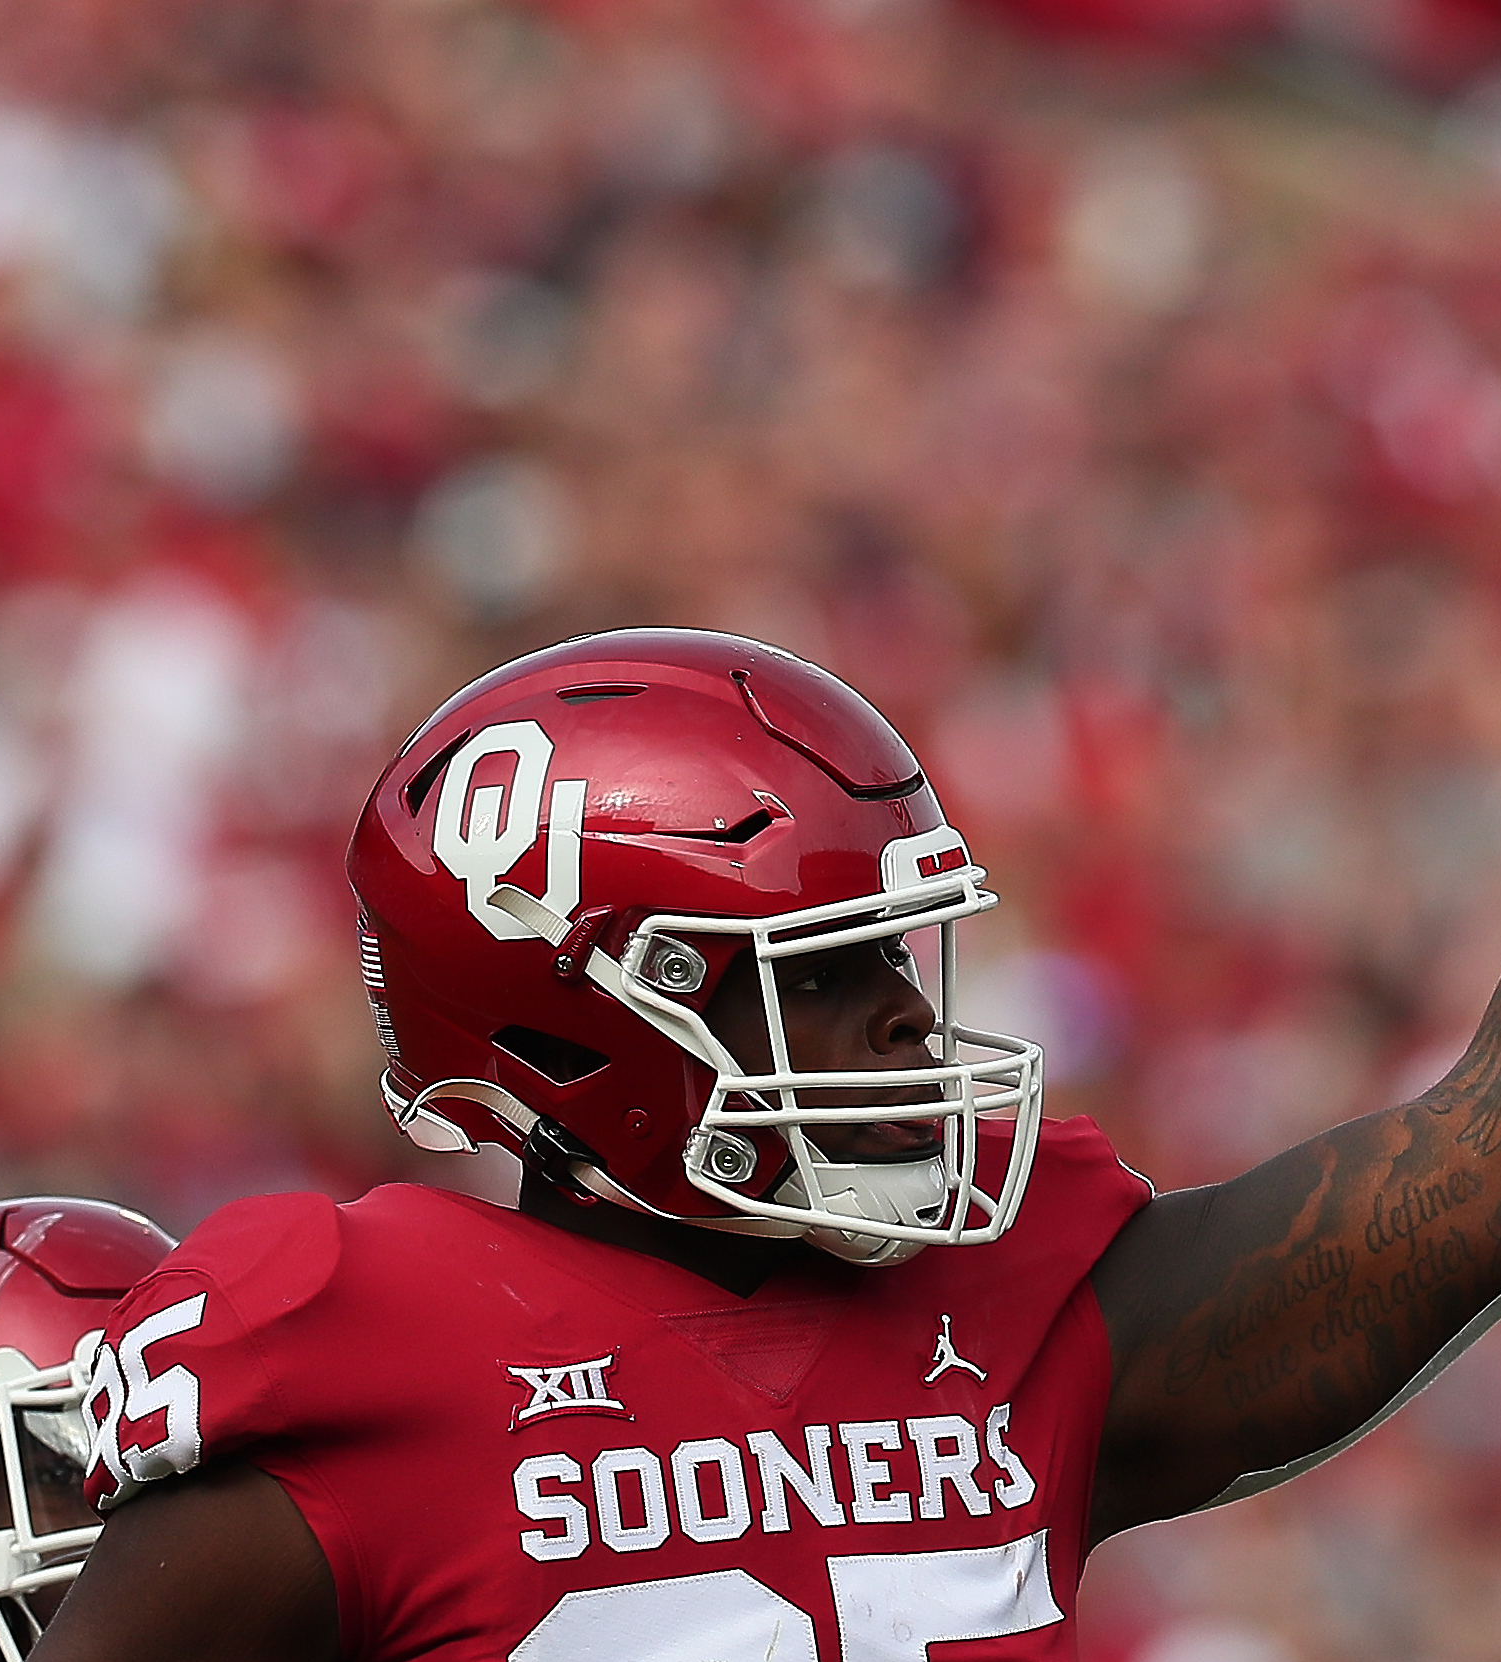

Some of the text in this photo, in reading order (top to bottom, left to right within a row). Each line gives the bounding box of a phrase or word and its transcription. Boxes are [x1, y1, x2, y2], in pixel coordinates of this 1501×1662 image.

[431, 719, 588, 941] OU
[1365, 1166, 1485, 1261] defines
[1310, 1225, 1478, 1353] character
[507, 1354, 626, 1421] XII
[513, 1403, 1037, 1562] SOONERS
